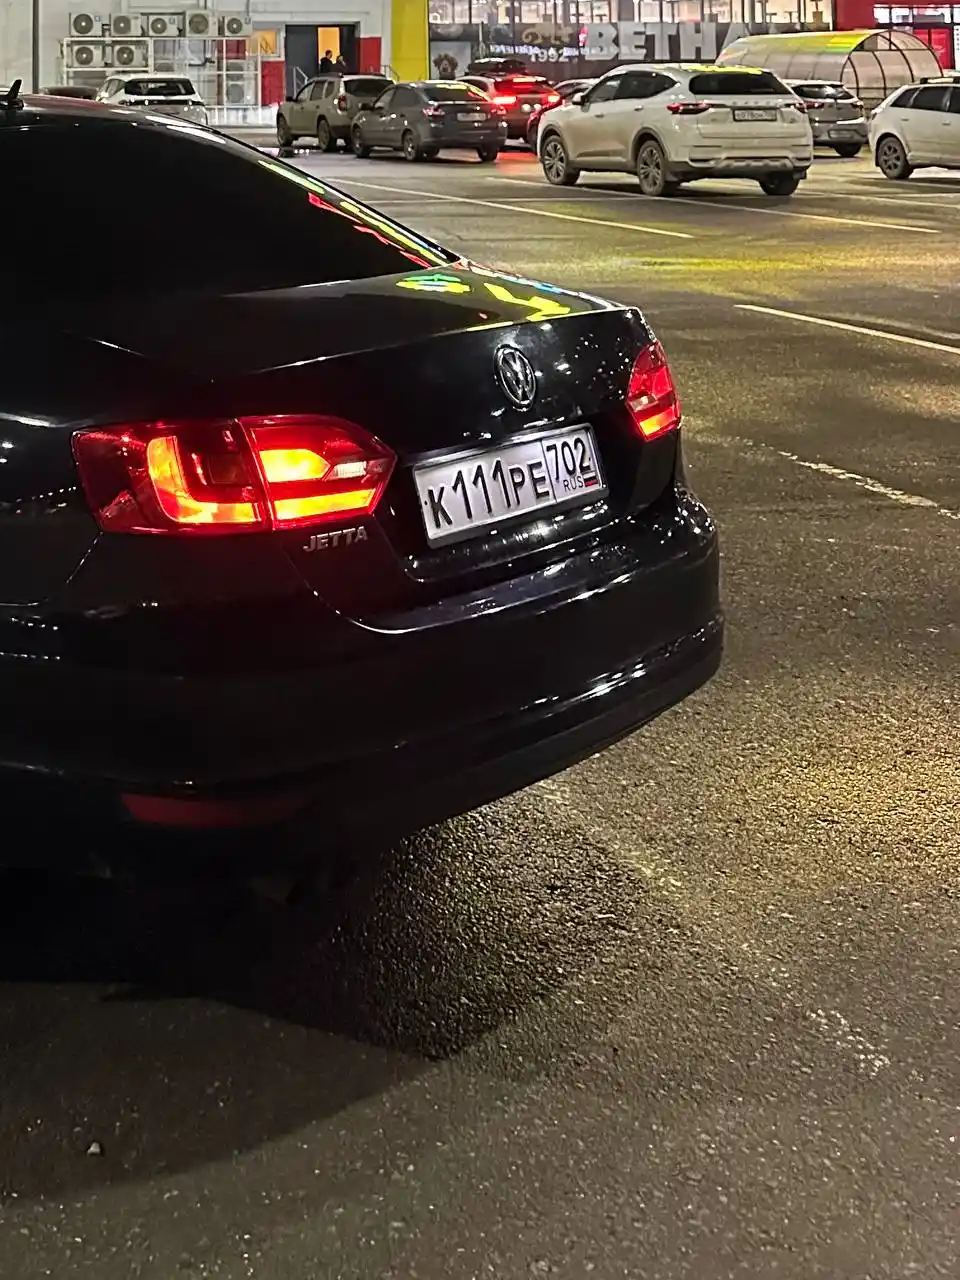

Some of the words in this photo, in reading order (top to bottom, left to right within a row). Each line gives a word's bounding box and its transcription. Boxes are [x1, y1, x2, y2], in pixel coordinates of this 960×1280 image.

[545, 437, 590, 483] 702
[563, 475, 585, 493] RUS
[303, 526, 368, 552] JETTA
